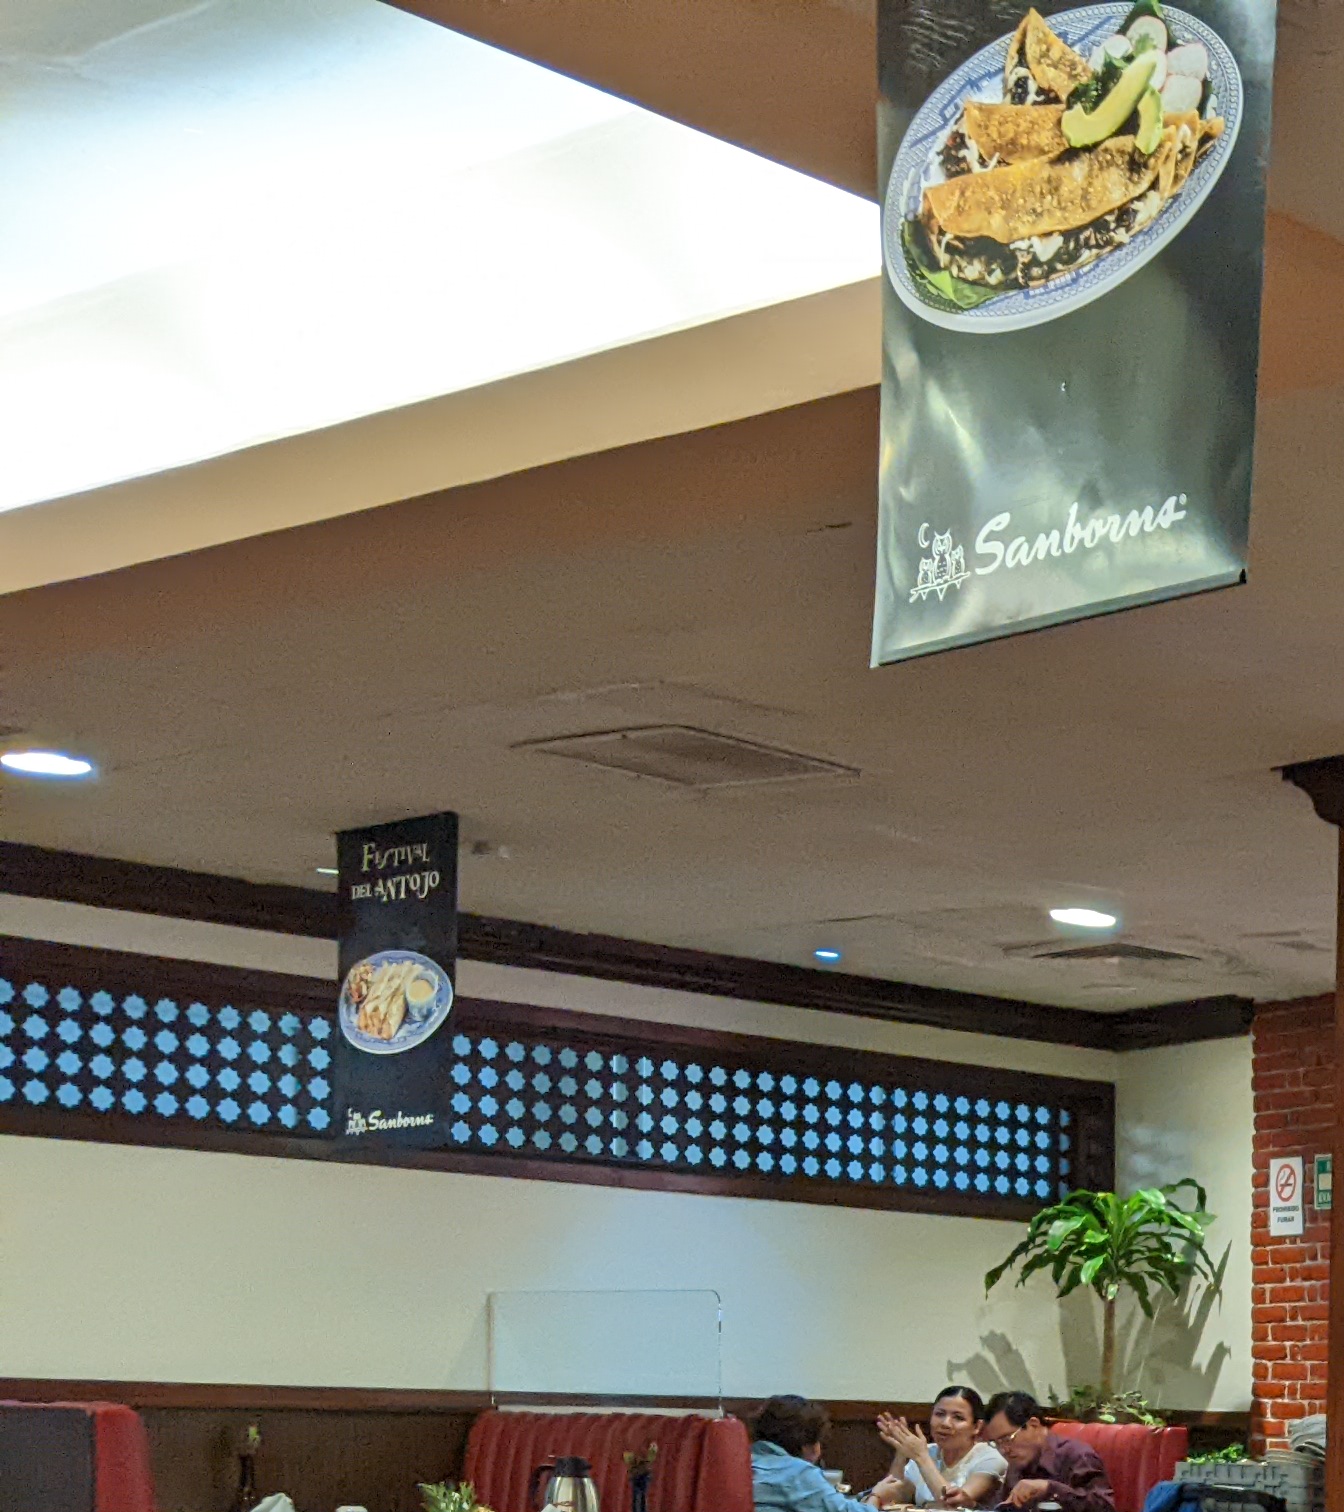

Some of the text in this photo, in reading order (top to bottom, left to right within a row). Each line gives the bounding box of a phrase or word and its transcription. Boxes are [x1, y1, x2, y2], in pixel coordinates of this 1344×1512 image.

[351, 870, 440, 902] DEL ANTOJO
[368, 1109, 434, 1131] Sanborns
